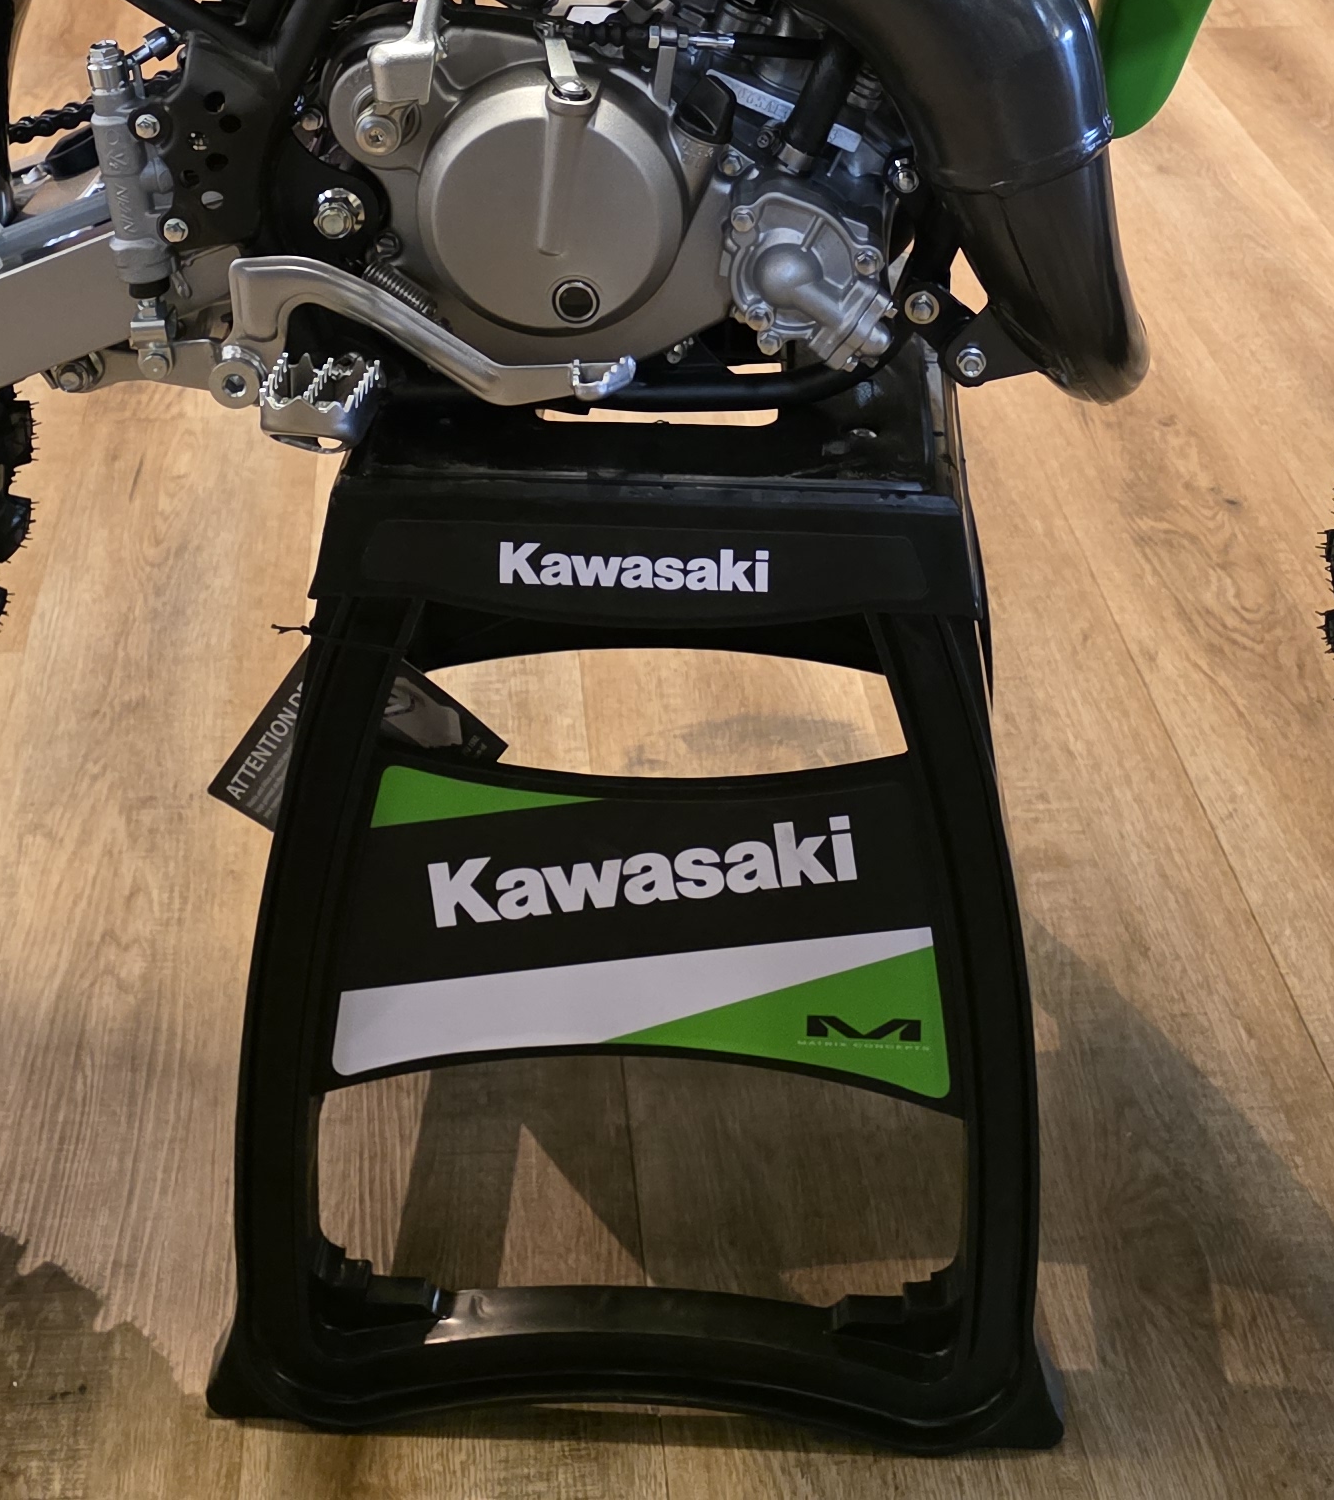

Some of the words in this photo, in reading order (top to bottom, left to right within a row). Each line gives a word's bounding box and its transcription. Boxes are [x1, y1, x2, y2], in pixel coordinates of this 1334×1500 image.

[499, 541, 770, 593] Kawasaki
[225, 706, 298, 800] ATTENTION
[427, 815, 858, 929] Kawasaki
